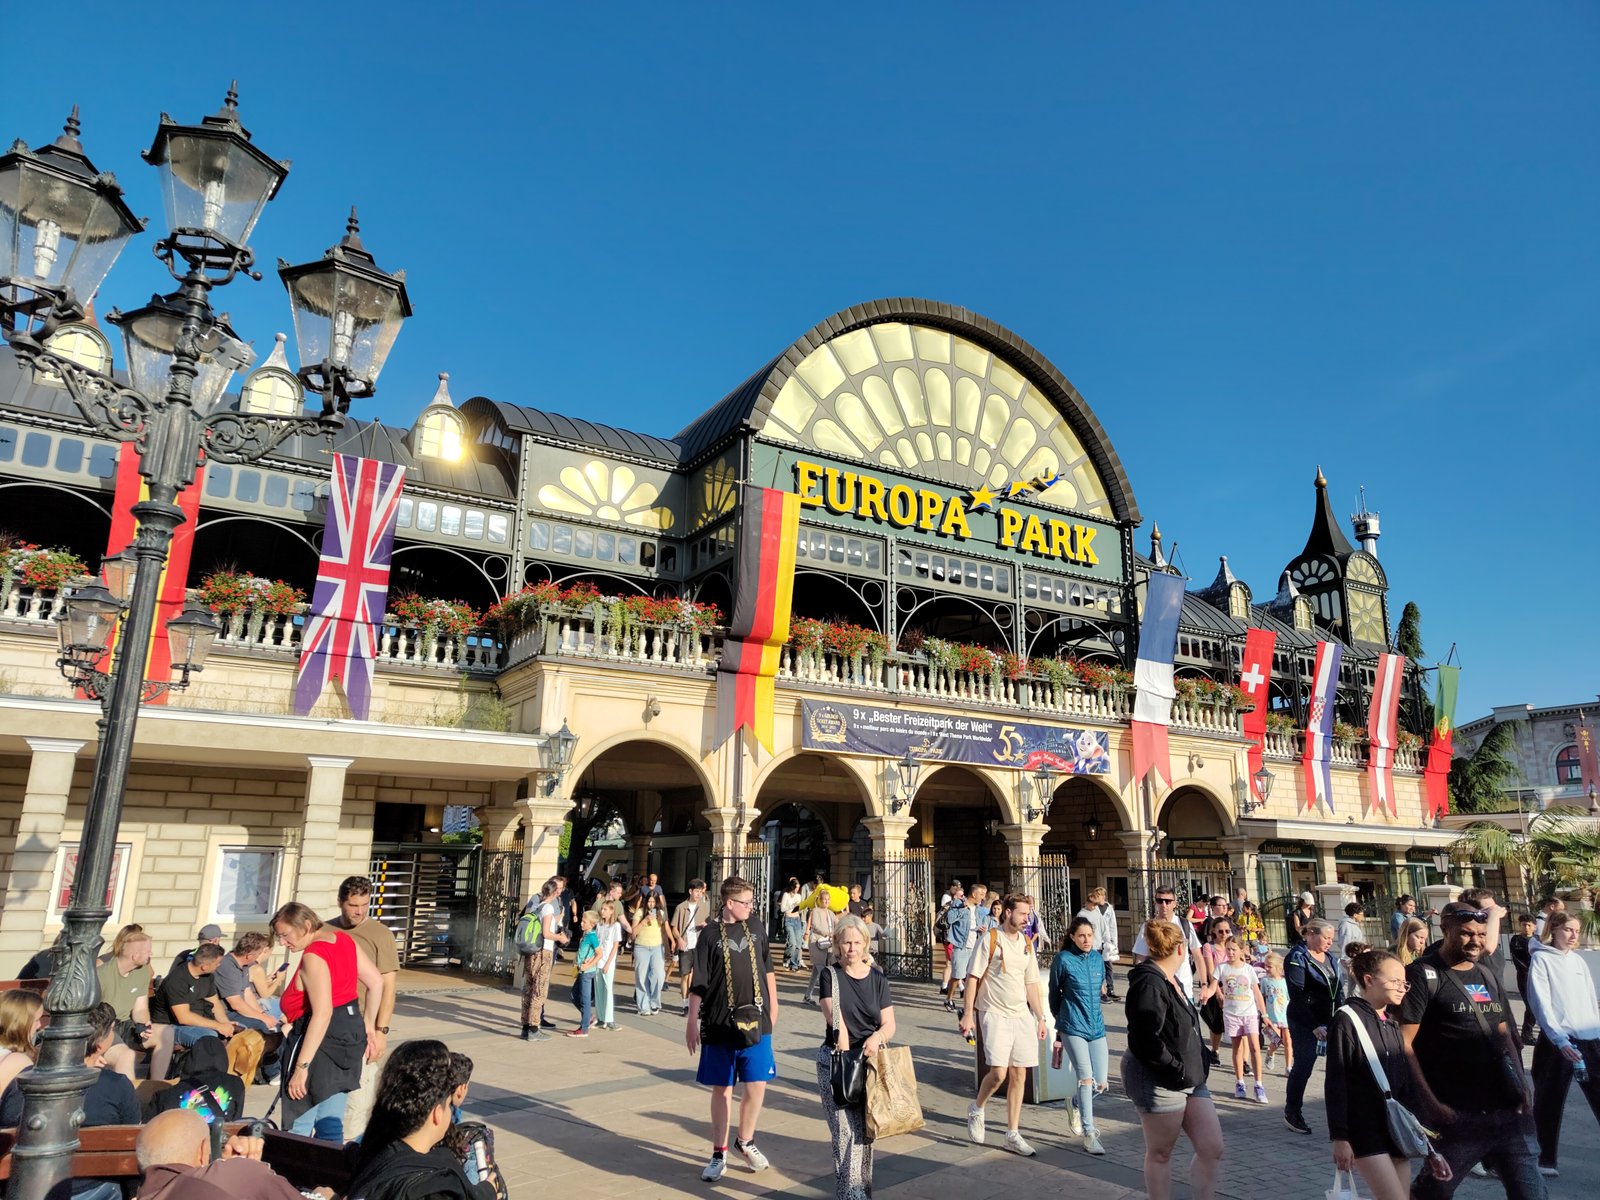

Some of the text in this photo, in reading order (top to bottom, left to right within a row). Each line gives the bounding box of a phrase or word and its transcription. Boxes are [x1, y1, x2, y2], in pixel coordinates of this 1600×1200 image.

[795, 460, 1100, 566] EUROPA PARK
[853, 708, 860, 720] 9
[860, 711, 866, 721] x
[868, 710, 902, 724] „Bester
[903, 713, 954, 730] Freizeitpark
[955, 719, 969, 731] der
[1263, 843, 1302, 854] Information
[1340, 847, 1375, 857] Information
[1410, 851, 1433, 860] Informa
[1452, 1001, 1466, 1013] LA
